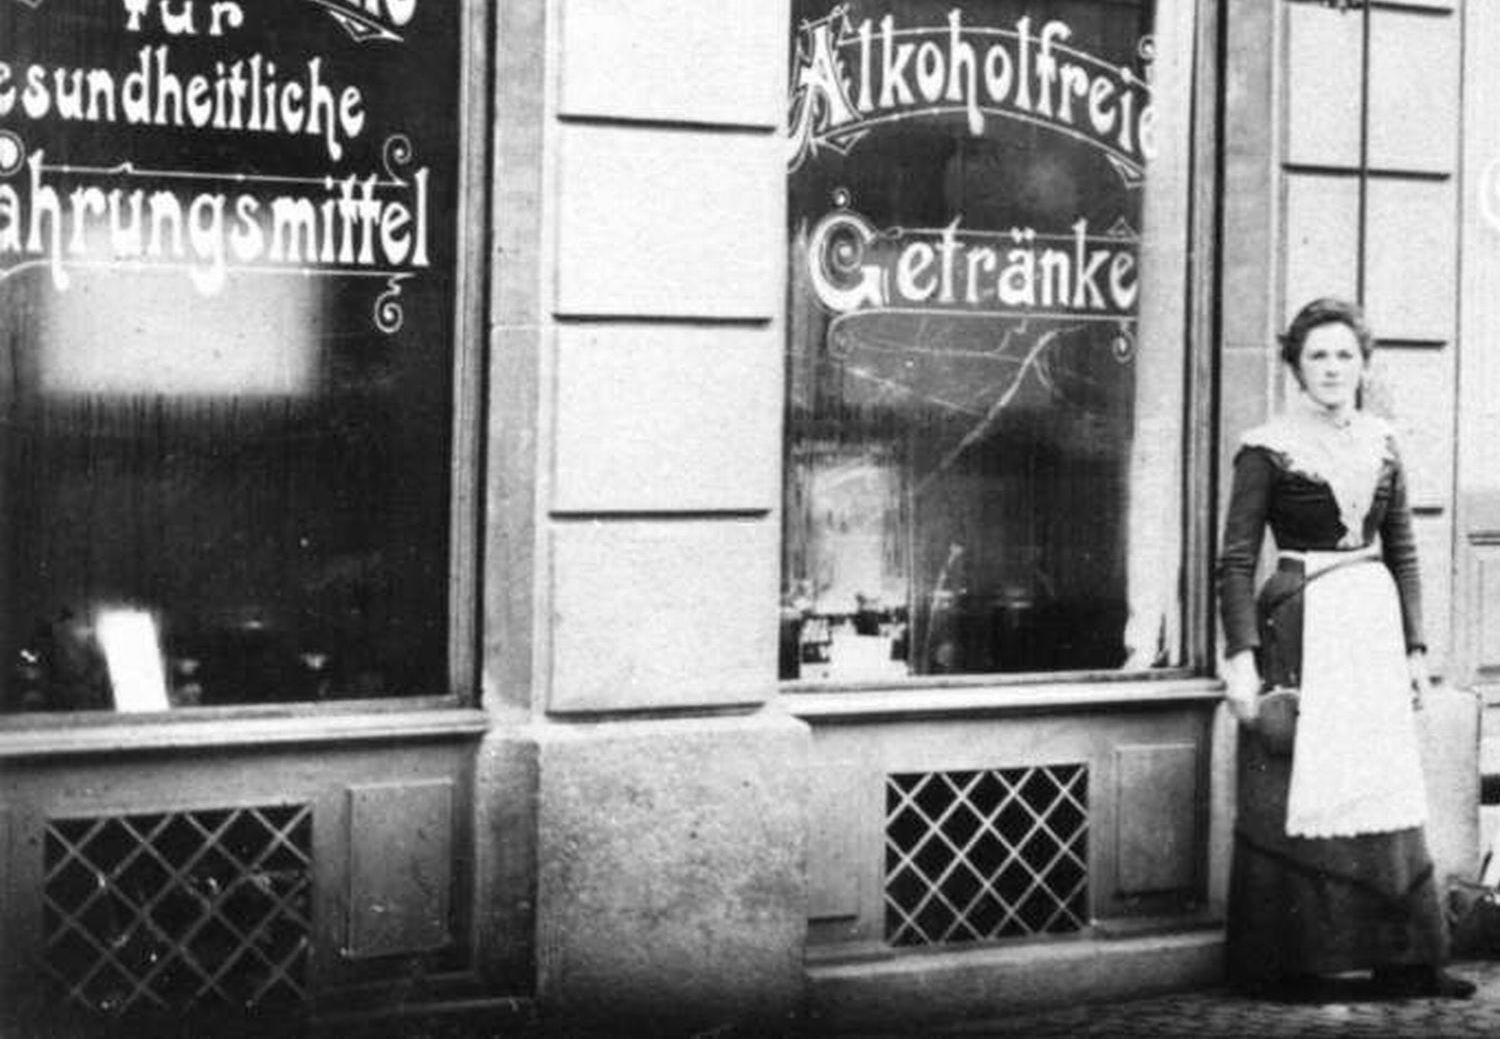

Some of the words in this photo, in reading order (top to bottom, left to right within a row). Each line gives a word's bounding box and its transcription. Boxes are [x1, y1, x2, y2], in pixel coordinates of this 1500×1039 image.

[0, 45, 364, 159] esundheitliche
[0, 149, 429, 294] ahrungsmittel
[808, 213, 1138, 314] Getränke
